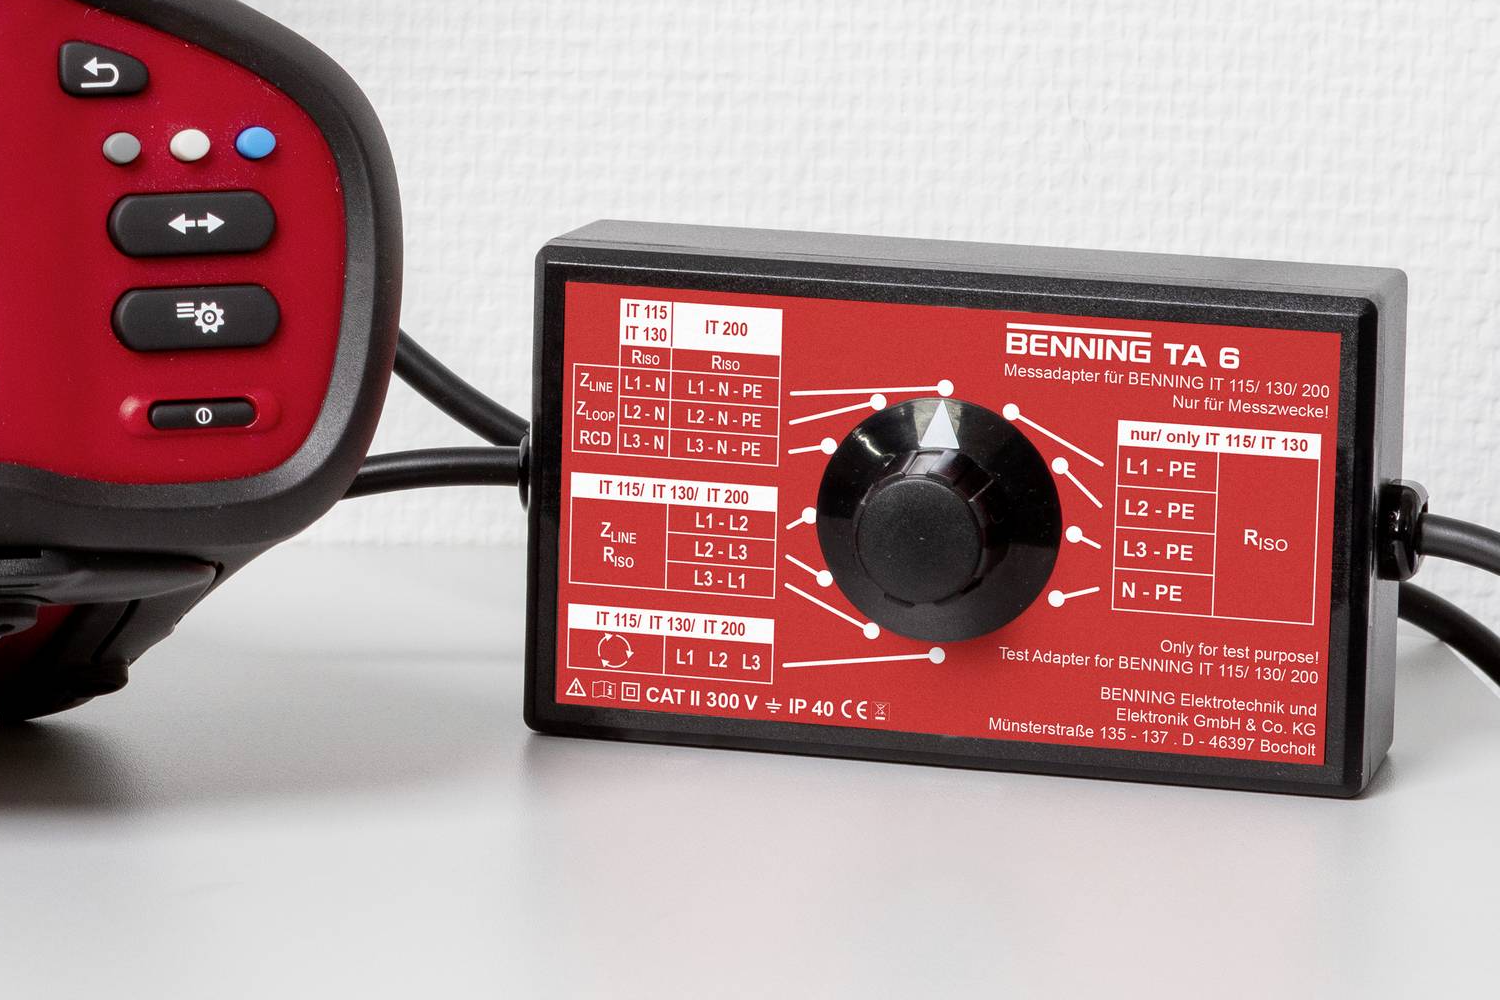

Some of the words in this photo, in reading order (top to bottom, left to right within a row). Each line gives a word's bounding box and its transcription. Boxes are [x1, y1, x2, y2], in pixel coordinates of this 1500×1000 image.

[627, 304, 639, 318] IT
[644, 305, 667, 319] 115
[626, 326, 638, 340] IT
[644, 327, 667, 341] 130
[706, 320, 718, 334] IT
[723, 322, 748, 336] 200
[1006, 333, 1151, 364] BENNING
[1164, 343, 1207, 367] TA
[1219, 348, 1240, 369] 6
[625, 376, 640, 390] L1
[688, 380, 704, 394] L1
[743, 384, 762, 398] PE
[1004, 364, 1100, 385] Messadapter
[1104, 370, 1124, 384] für
[1128, 372, 1204, 390] BENNING
[1210, 377, 1225, 391] IT
[1230, 379, 1260, 393] 115/
[1266, 381, 1297, 396] 130/
[1302, 384, 1329, 398] 200
[624, 405, 641, 419] L2
[1173, 396, 1198, 410] Nur
[1204, 397, 1224, 411] für
[1229, 399, 1329, 419] Messzwecke!
[688, 409, 704, 424] L2
[742, 413, 761, 427] PE
[580, 431, 611, 446] RCD
[624, 434, 640, 448] L3
[687, 439, 703, 453] L3
[742, 442, 761, 457] PE
[1131, 430, 1161, 441] nur/
[1167, 431, 1200, 448] only
[1206, 433, 1219, 446] IT
[1226, 434, 1256, 448] 115/
[1262, 437, 1275, 449] IT
[1281, 438, 1308, 452] 130
[1126, 458, 1148, 475] L1
[1169, 461, 1196, 478] PE
[600, 480, 612, 494] IT
[617, 482, 644, 497] 115/
[653, 485, 665, 498] IT
[670, 486, 698, 501] 130/
[708, 488, 720, 502] IT
[725, 490, 748, 504] 200
[1125, 499, 1148, 517] L2
[1168, 503, 1194, 520] PE
[696, 513, 712, 528] L1
[730, 515, 748, 531] L2
[695, 541, 713, 558] L2
[729, 544, 747, 560] L3
[1123, 541, 1147, 558] L3
[1166, 544, 1193, 561] PE
[694, 570, 712, 586] L3
[728, 573, 745, 589] L1
[1122, 582, 1136, 598] N
[1155, 584, 1182, 601] PE
[596, 612, 609, 625] IT
[614, 613, 642, 629] 115/
[650, 616, 662, 629] IT
[667, 617, 695, 633] 130/
[704, 620, 716, 633] IT
[721, 621, 745, 636] 200
[677, 649, 694, 665] L1
[709, 652, 727, 668] L2
[743, 654, 760, 670] L3
[1160, 640, 1193, 657] Only
[1199, 643, 1218, 656] for
[1223, 645, 1250, 659] test
[1254, 648, 1319, 664] purpose!
[999, 647, 1029, 662] Test
[1033, 649, 1090, 667] Adapter
[1095, 654, 1114, 667] for
[1118, 658, 1193, 674] BENNING
[1200, 663, 1213, 676] IT
[1219, 665, 1249, 679] 115/
[1255, 667, 1286, 682] 130/
[1291, 670, 1318, 684] 200
[646, 687, 684, 705] CAT
[690, 691, 700, 706] II
[707, 692, 739, 709] 300
[744, 695, 758, 710] V
[789, 699, 806, 714] IP
[812, 700, 833, 716] 40
[1101, 687, 1175, 705] BENNING
[1181, 693, 1284, 713] Elektrotechnik
[1290, 703, 1316, 717] und
[1116, 708, 1188, 726] Elektronik
[1194, 715, 1241, 730] GmbH
[1262, 720, 1287, 734] Co.
[1293, 723, 1316, 736] KG
[989, 717, 1094, 738] Münsterstraße
[1100, 727, 1126, 740] 135
[1142, 730, 1168, 744] 137
[1209, 735, 1255, 751] 46397
[1260, 739, 1316, 756] Bocholt
